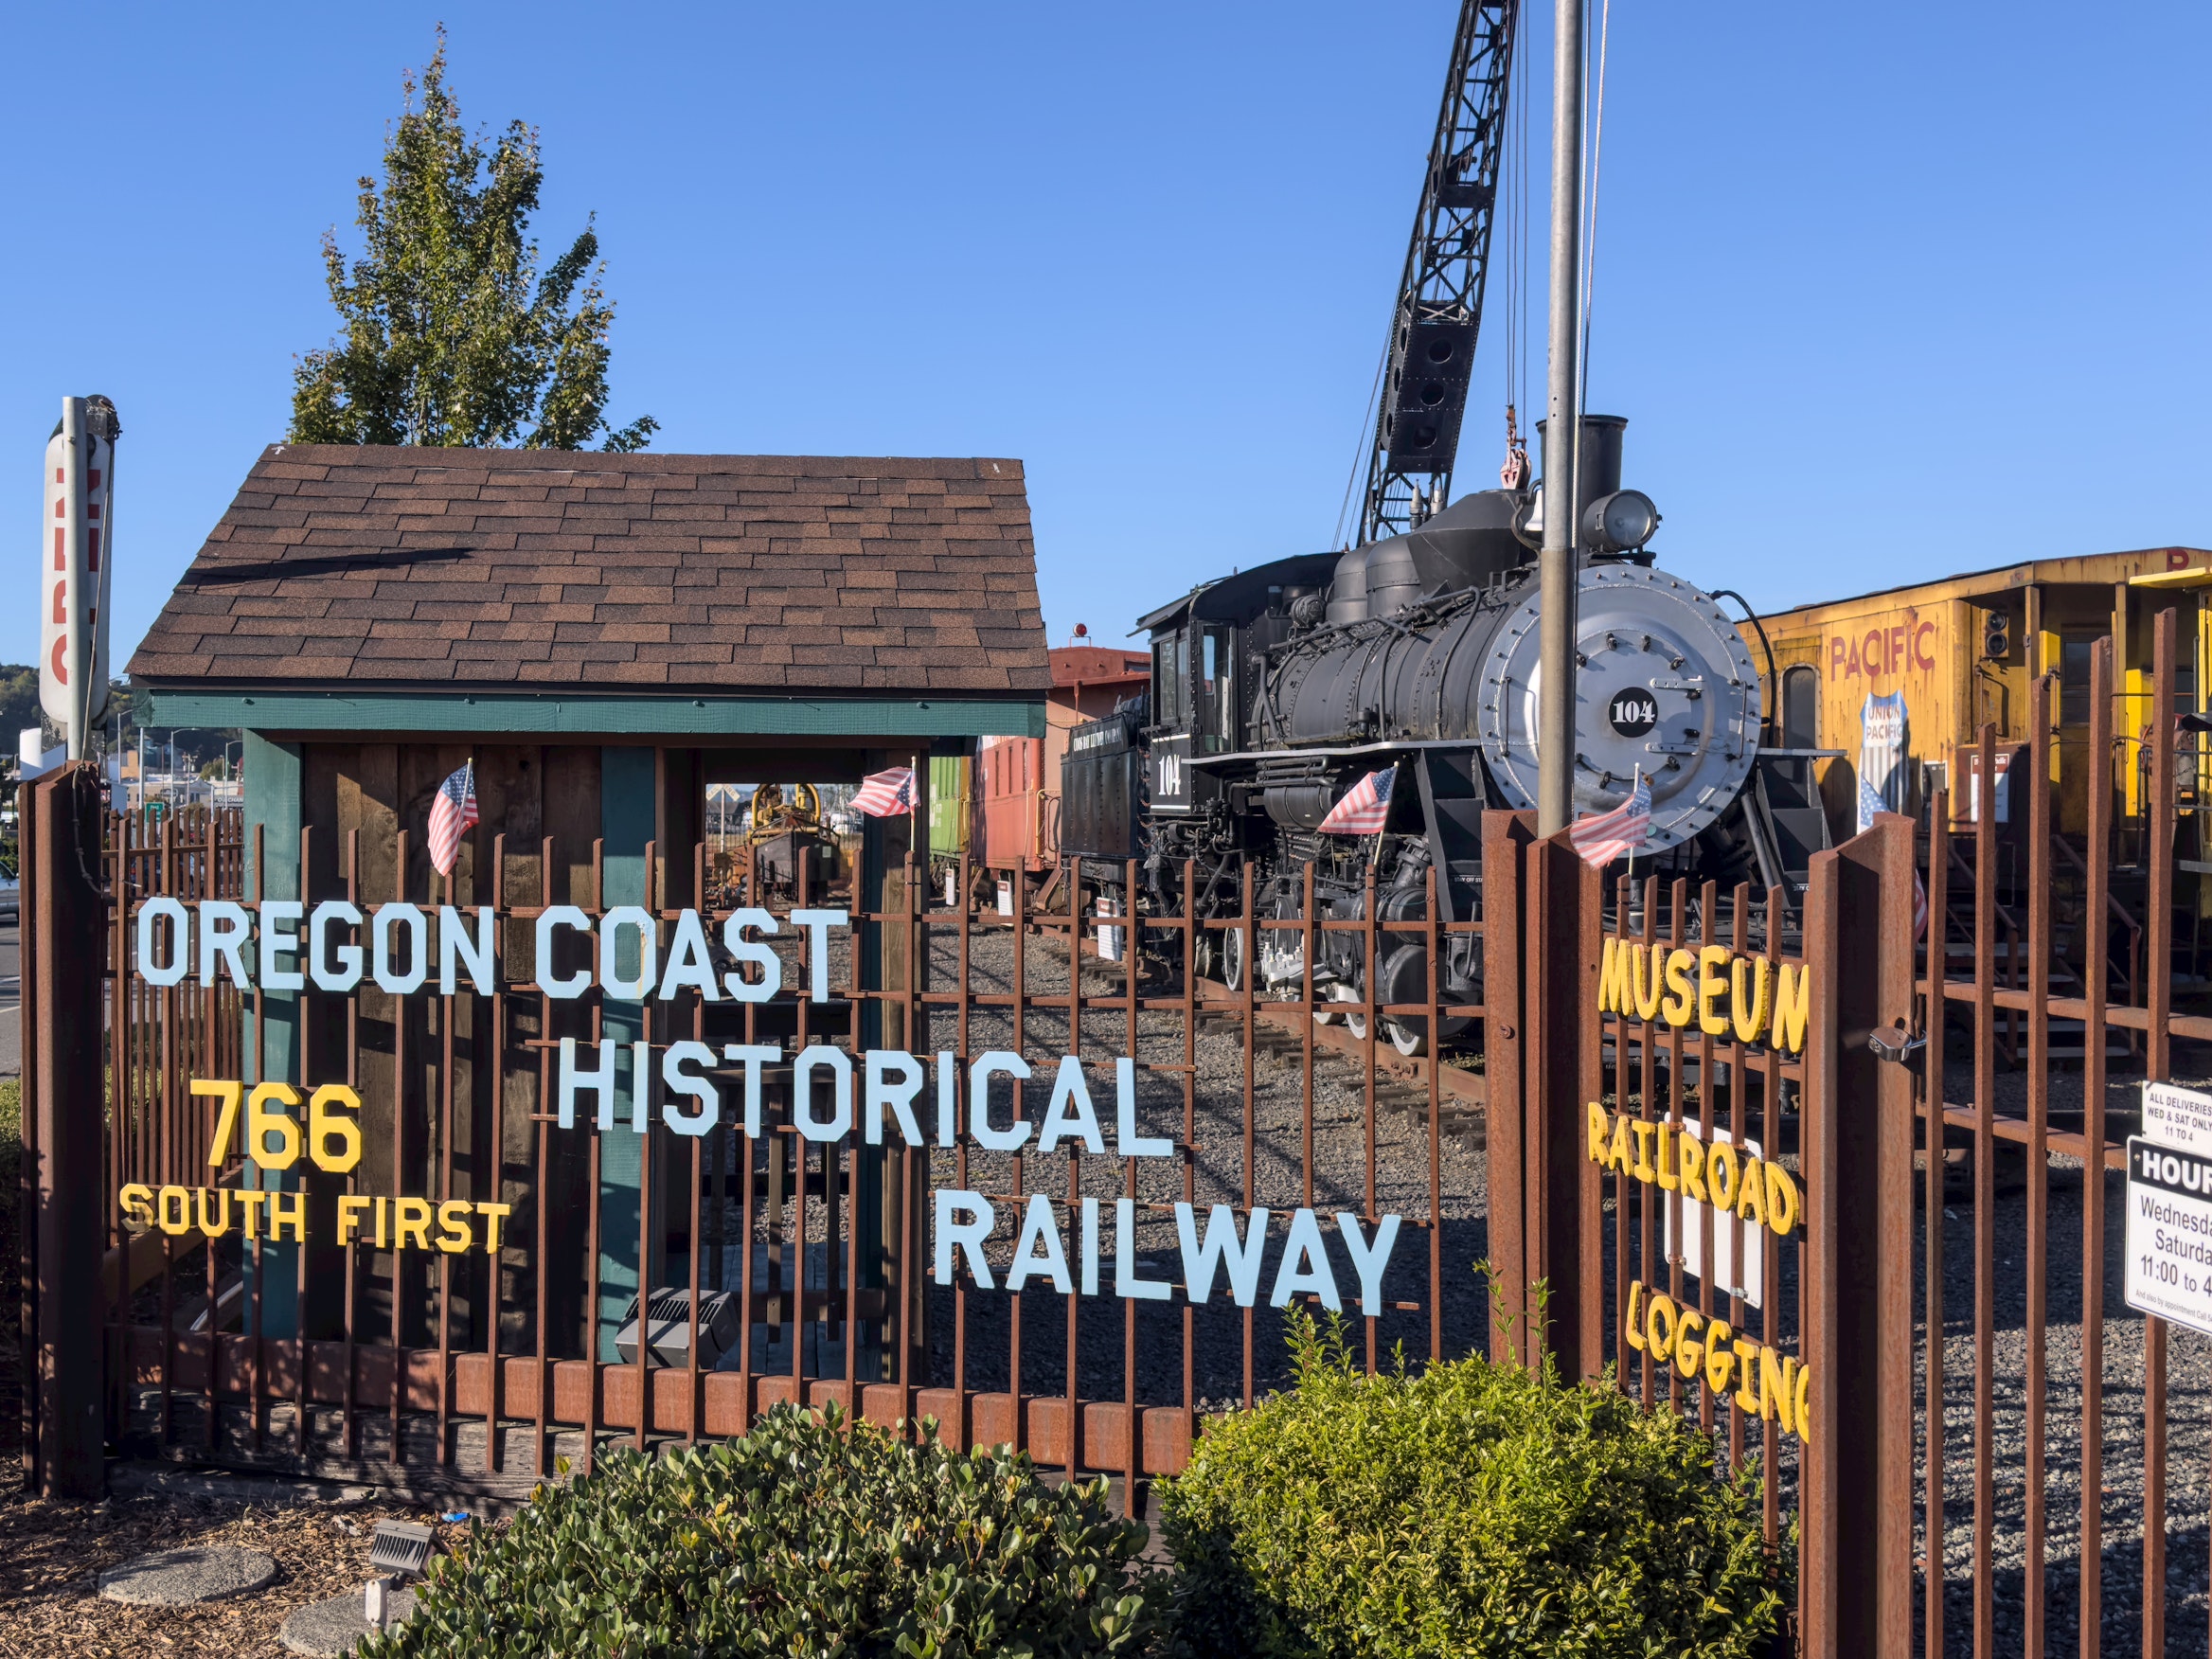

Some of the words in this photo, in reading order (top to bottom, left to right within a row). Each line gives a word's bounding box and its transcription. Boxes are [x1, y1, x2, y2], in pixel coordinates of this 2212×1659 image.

[1831, 621, 1936, 682] PACIFIC
[1613, 701, 1656, 723] 104
[1865, 724, 1902, 740] PACIFIC
[1867, 705, 1900, 721] UNION
[1158, 754, 1181, 795] 104
[137, 897, 495, 997] OREGON
[535, 905, 849, 1004] COAST
[1598, 937, 1810, 1054] MUSEUM
[558, 1037, 1174, 1157] HISTORICAL
[2149, 1092, 2164, 1105] ALL
[2166, 1096, 2212, 1117] DELIVERIES
[189, 1079, 362, 1173] 766
[2148, 1106, 2165, 1119] WED
[2167, 1111, 2172, 1121] &
[2175, 1113, 2190, 1126] SAT
[2191, 1117, 2212, 1132] ONLY
[2165, 1125, 2173, 1136] 11
[2176, 1128, 2186, 1140] TO
[2188, 1133, 2193, 1142] 4
[1587, 1101, 1799, 1235] RAILROAD
[119, 1183, 306, 1243] SOUTH
[336, 1195, 510, 1255] FIRST
[936, 1189, 1402, 1316] RAILWAY
[2155, 1228, 2212, 1267] Saturda
[2141, 1254, 2178, 1285] 11:00
[2185, 1273, 2197, 1292] to
[2136, 1288, 2146, 1300] And
[2146, 1293, 2156, 1303] also
[2157, 1295, 2165, 1307] by
[2165, 1300, 2196, 1318] appointment
[2197, 1310, 2207, 1321] Call
